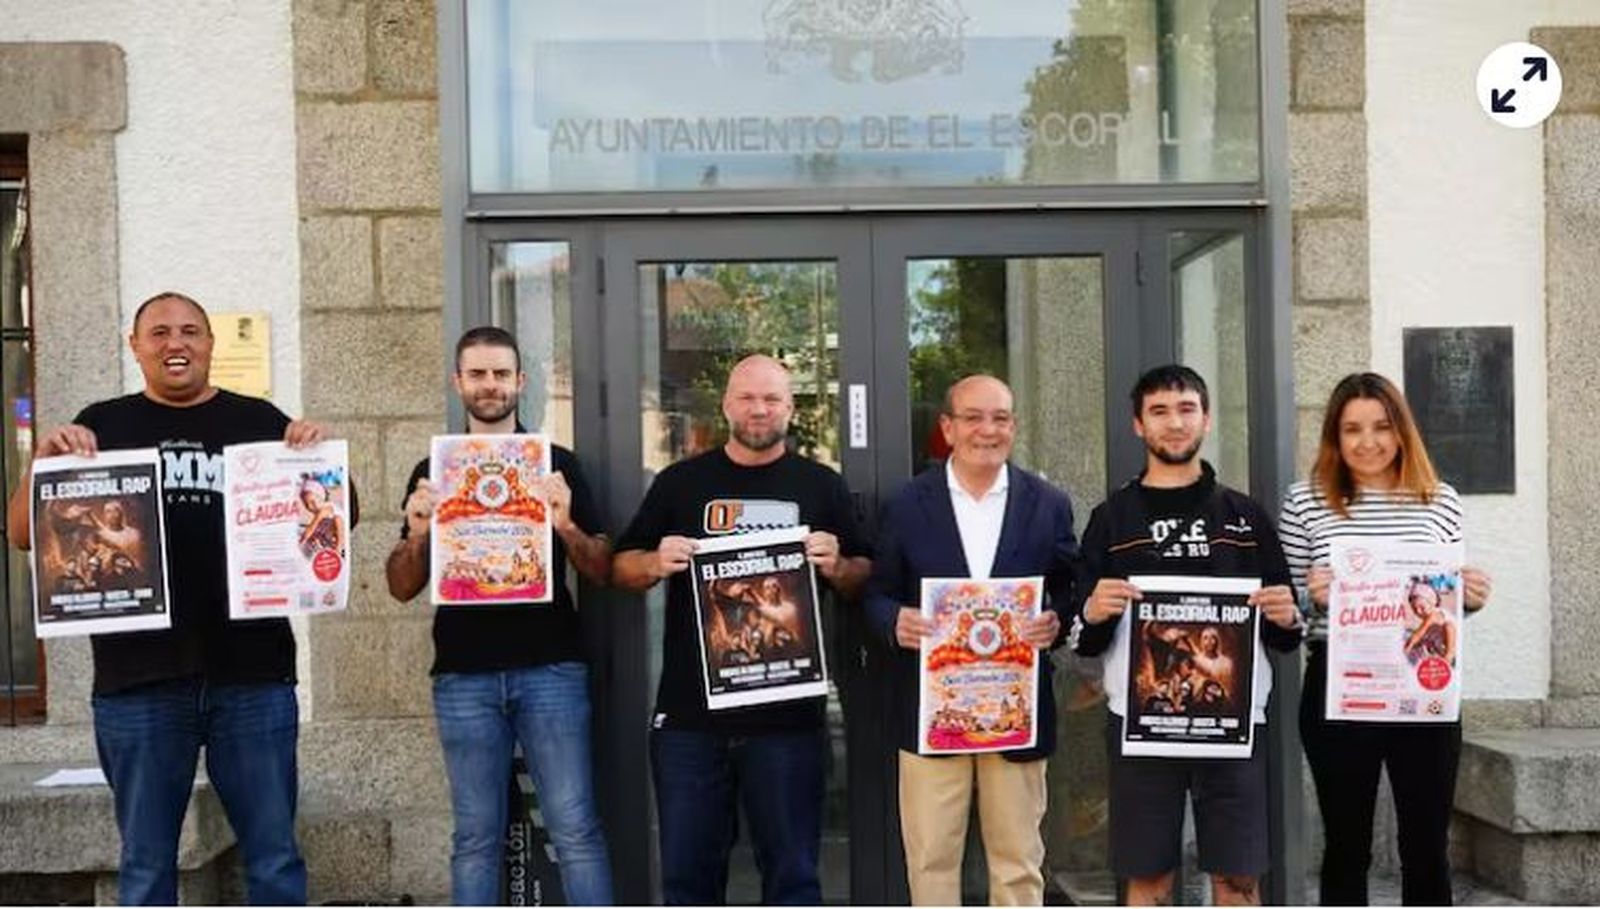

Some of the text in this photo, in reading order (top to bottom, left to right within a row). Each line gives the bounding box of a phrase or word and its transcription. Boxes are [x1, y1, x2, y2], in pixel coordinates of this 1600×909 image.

[549, 116, 847, 152] AYUNTAMIENTO
[860, 115, 912, 150] DE
[928, 114, 972, 149] EL
[41, 476, 152, 500] EL ESCORIAL RAP
[236, 500, 299, 526] CLAUDIA
[701, 563, 718, 581] EL
[718, 556, 776, 579] ESCORIAL
[777, 552, 805, 573] RAP
[1139, 603, 1251, 624] EL ESCORIAL RAP
[1339, 603, 1406, 627] CLAUDIA
